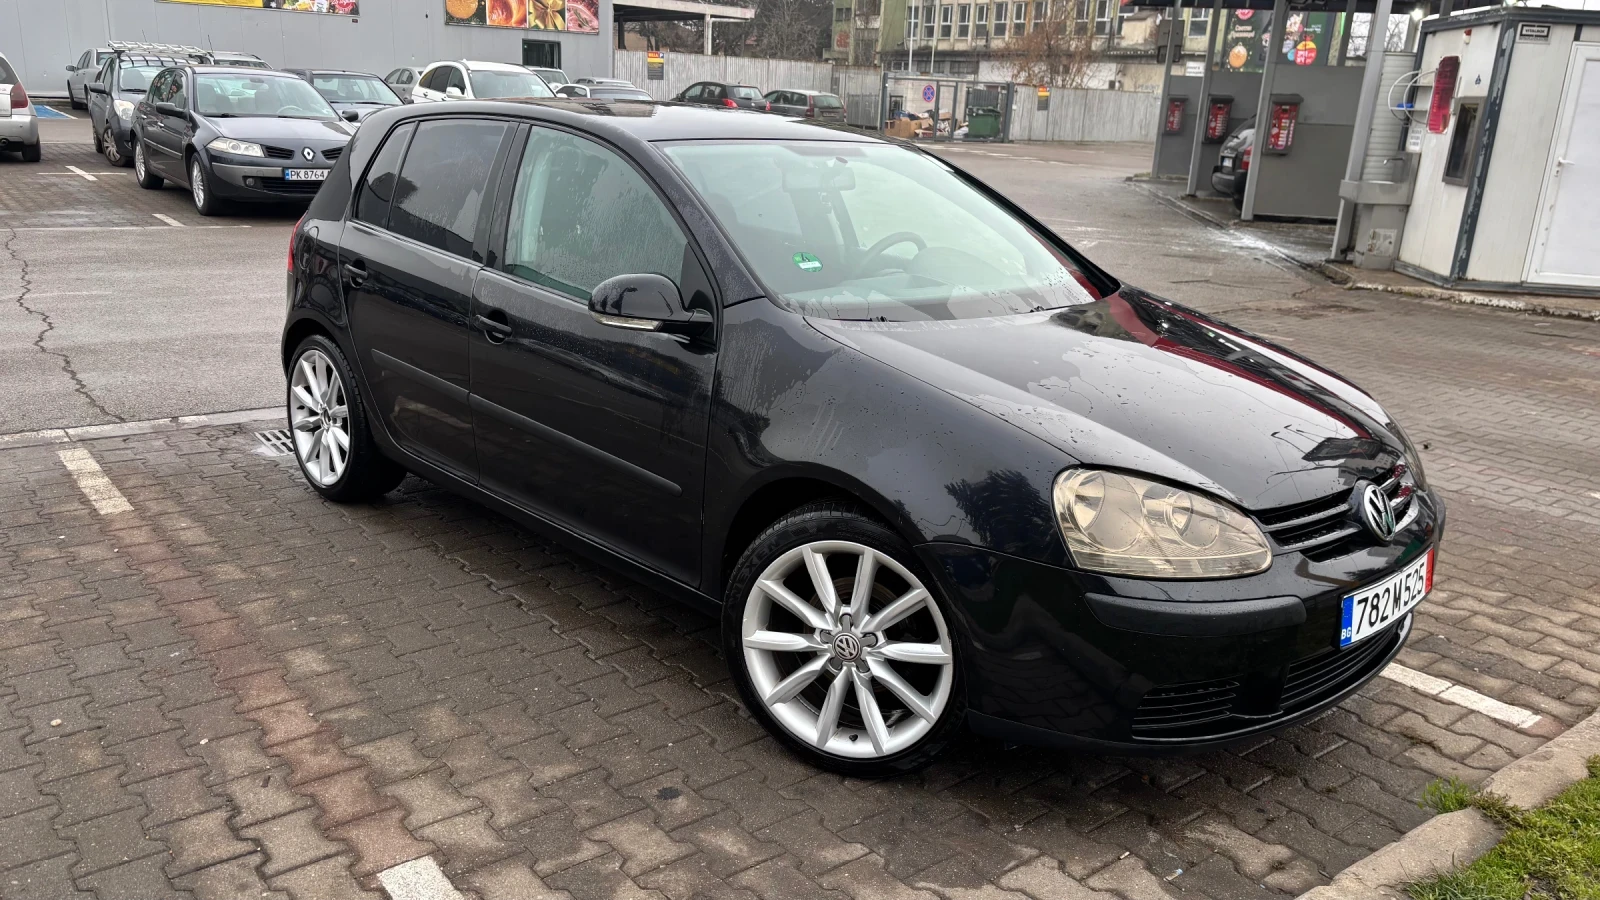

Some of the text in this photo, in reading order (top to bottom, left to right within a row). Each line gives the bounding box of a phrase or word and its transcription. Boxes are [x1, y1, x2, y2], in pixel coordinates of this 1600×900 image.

[290, 170, 302, 179] PK
[303, 170, 325, 179] 8764
[1341, 627, 1352, 640] BG
